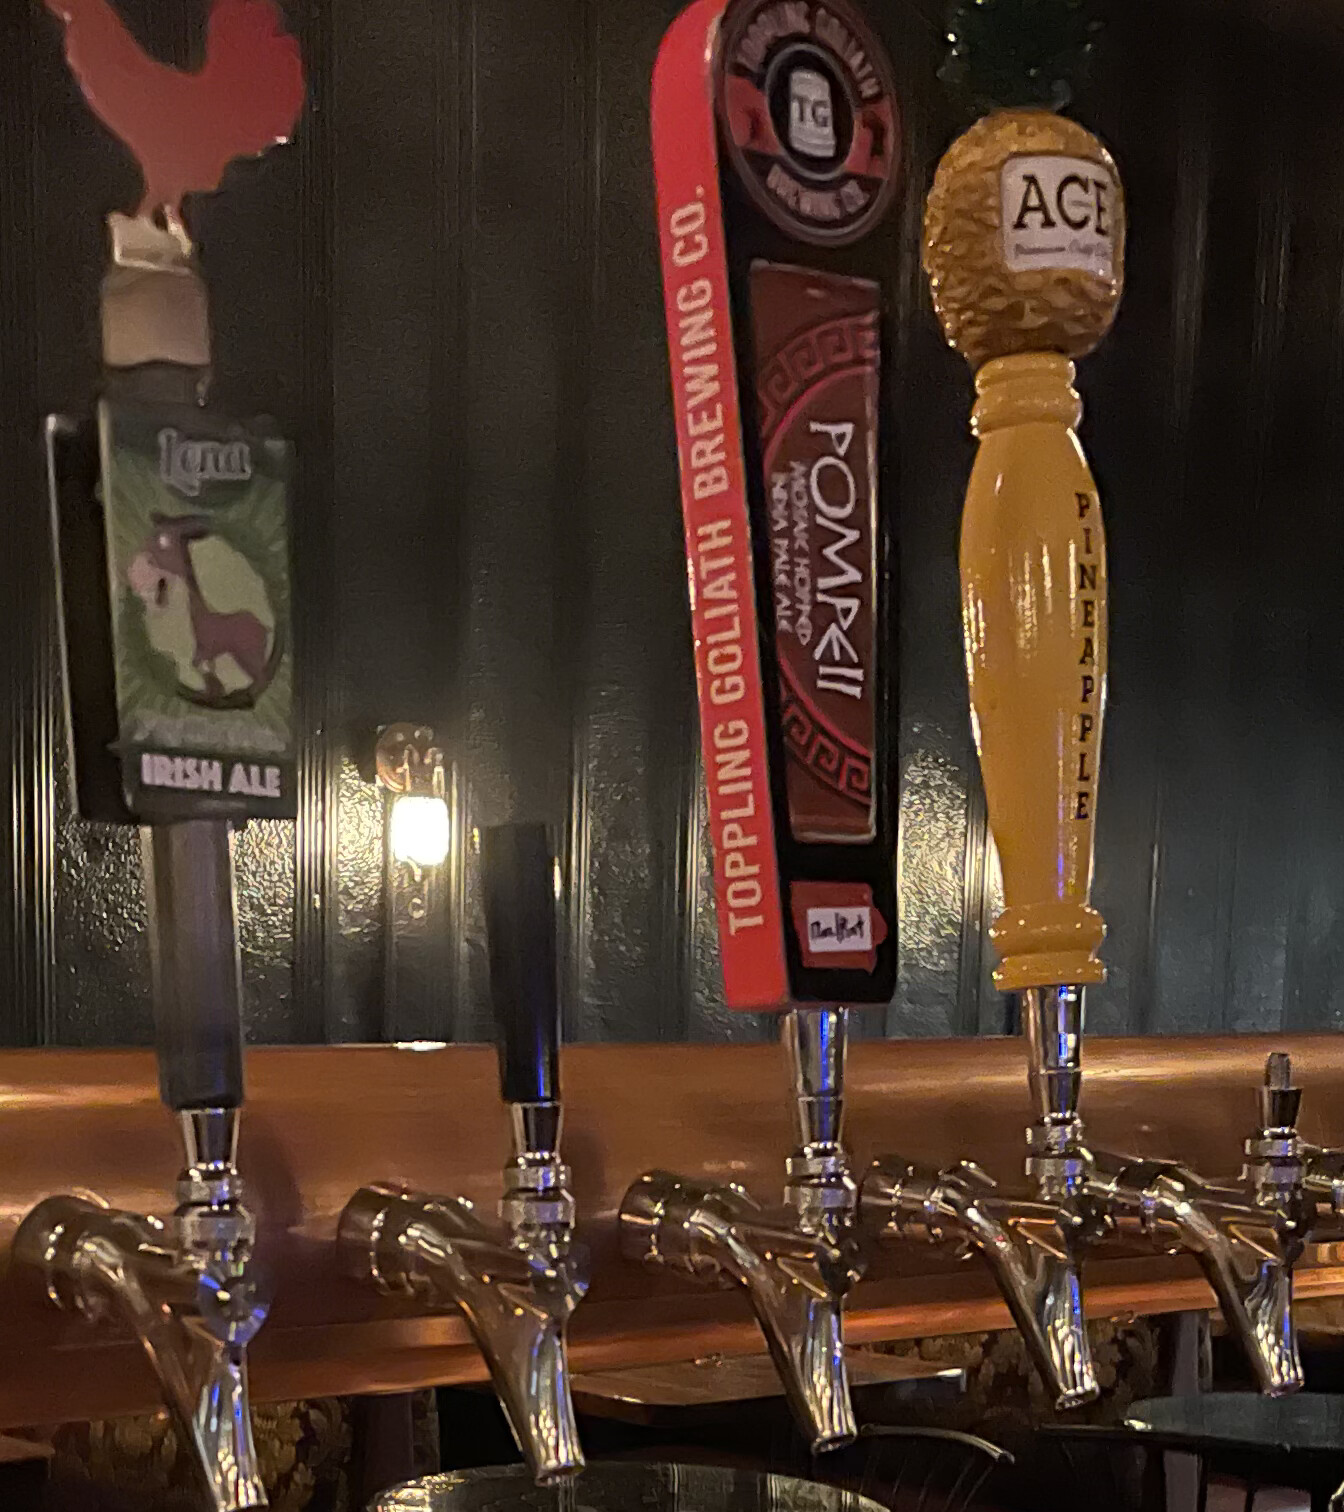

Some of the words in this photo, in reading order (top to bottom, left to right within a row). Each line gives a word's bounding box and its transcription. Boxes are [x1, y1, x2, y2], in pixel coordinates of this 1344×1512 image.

[670, 184, 710, 268] CO.
[1012, 172, 1108, 237] ACE
[158, 427, 253, 498] Lena
[676, 278, 730, 501] BREWING
[697, 517, 746, 706] GOLIATH
[809, 421, 865, 700] POMPEII
[1074, 491, 1098, 821] PINEAPPLE
[141, 752, 223, 792] IRISH
[228, 762, 281, 798] ALE
[713, 718, 764, 936] TOPPLING
